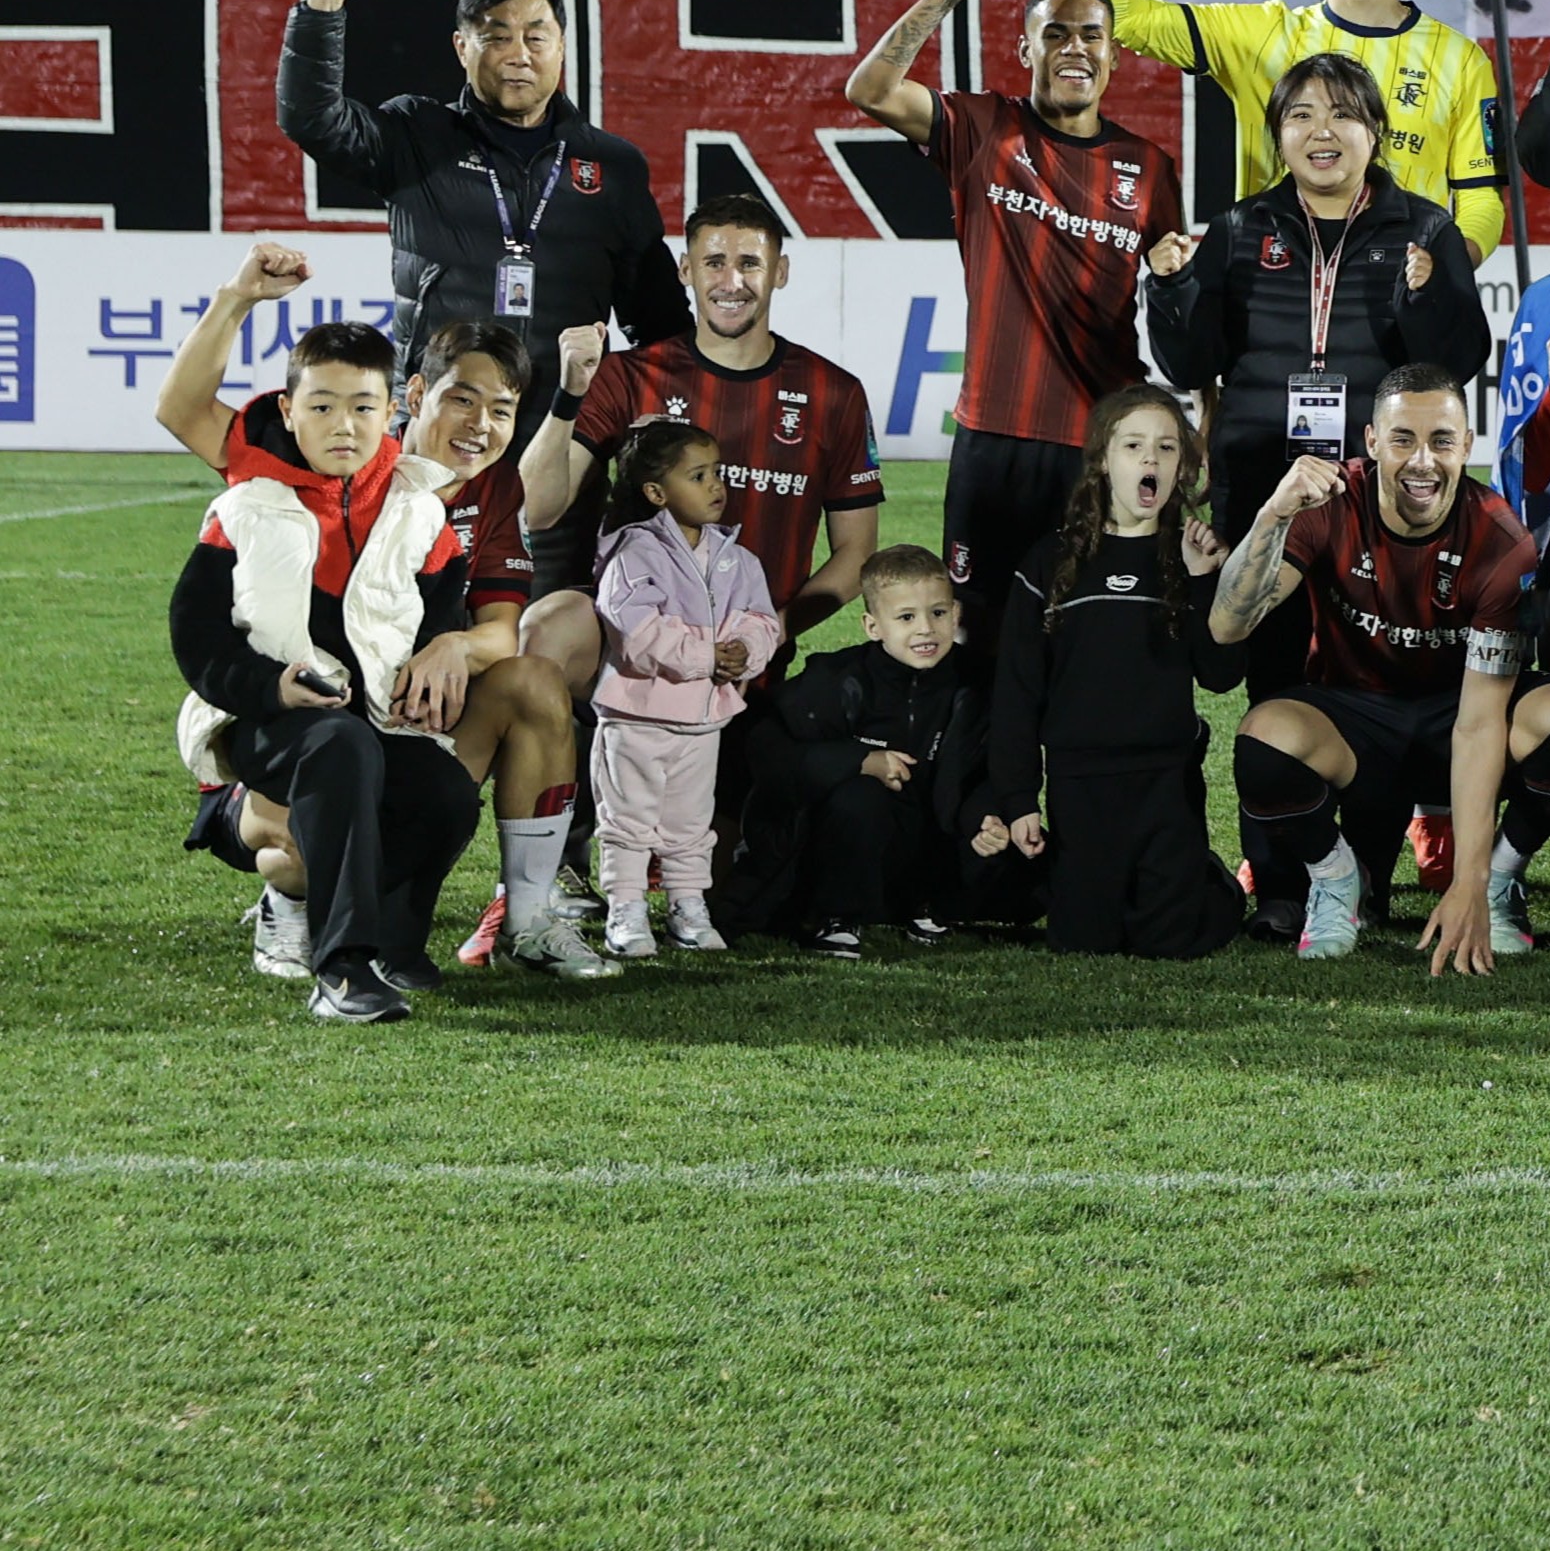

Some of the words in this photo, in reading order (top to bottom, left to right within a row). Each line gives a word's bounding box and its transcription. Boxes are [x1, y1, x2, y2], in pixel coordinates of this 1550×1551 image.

[986, 182, 1142, 254] 부천자생한방병원
[722, 460, 808, 497] 한방병원
[1468, 644, 1522, 664] CAPTA
